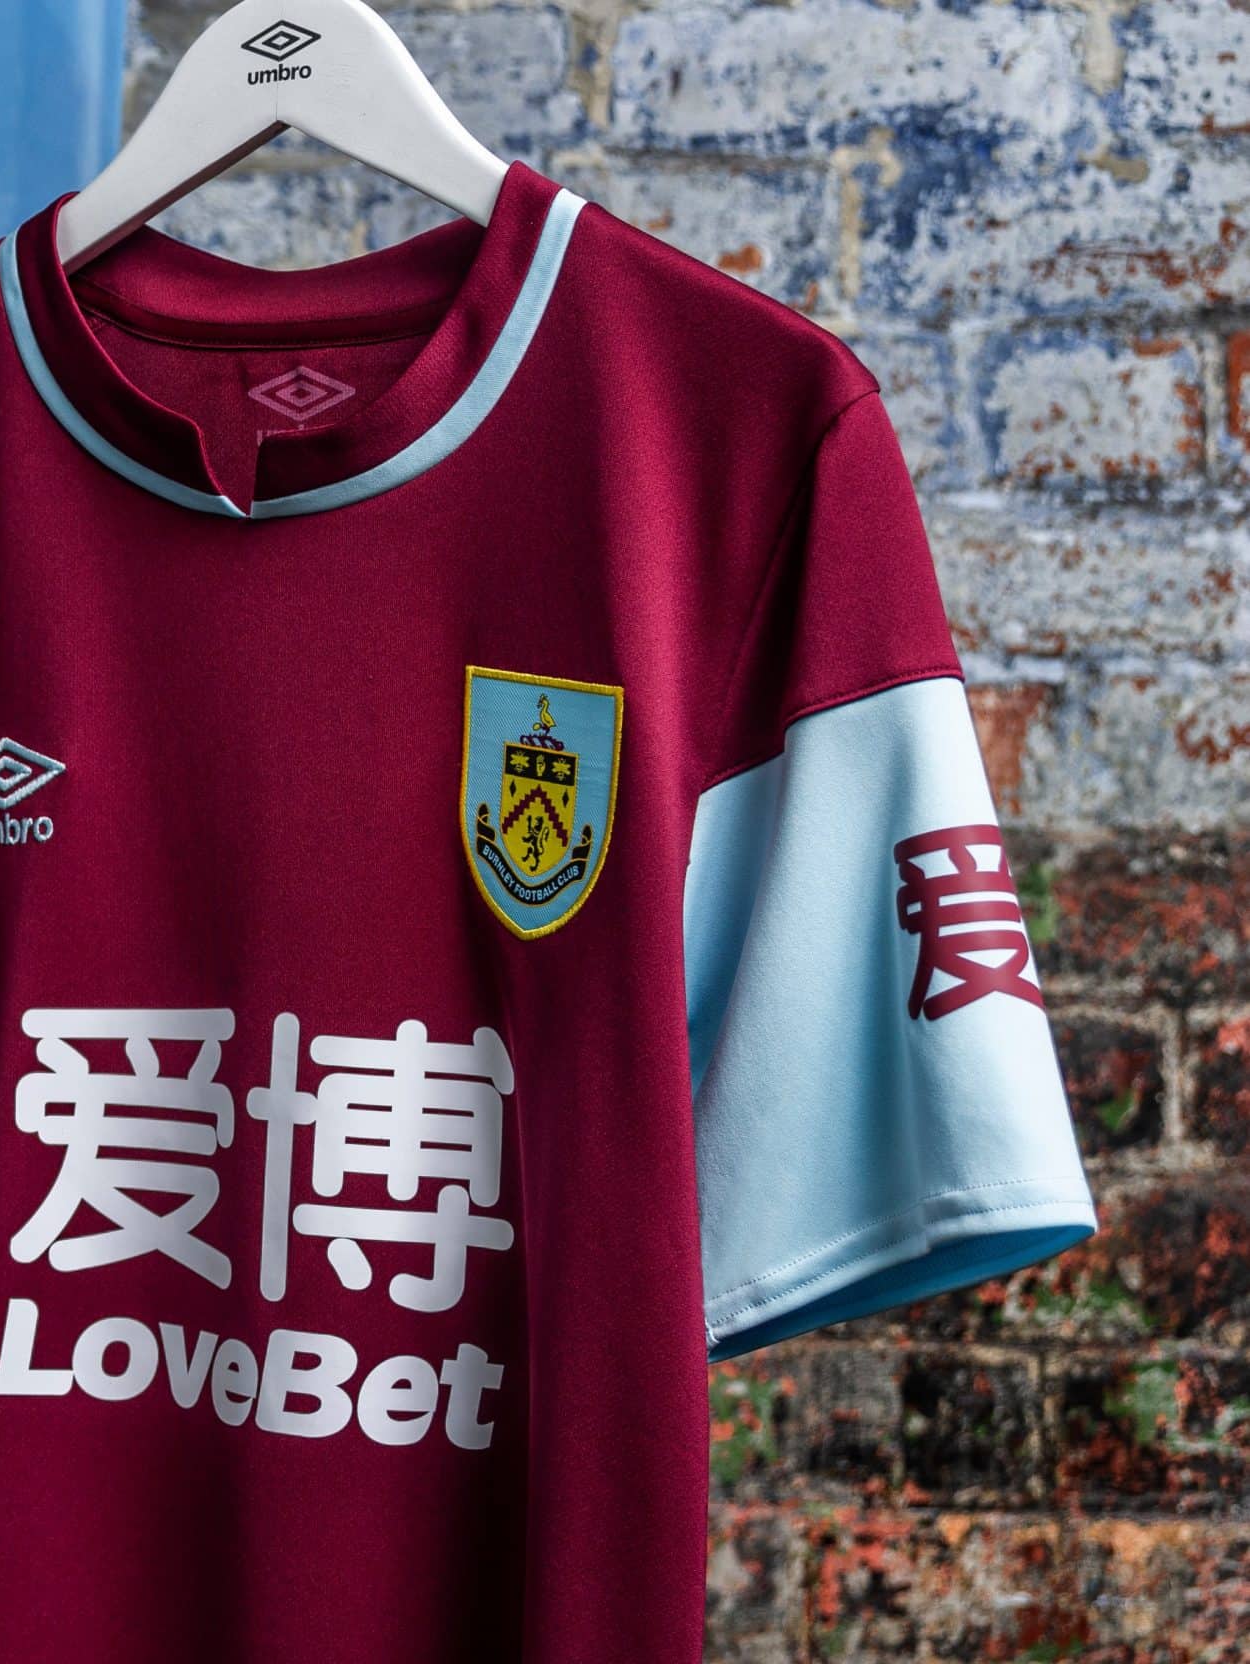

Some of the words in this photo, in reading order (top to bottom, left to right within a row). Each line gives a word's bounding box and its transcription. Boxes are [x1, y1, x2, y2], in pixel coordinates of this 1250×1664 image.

[247, 63, 312, 85] umbro
[482, 844, 515, 888] BURNLEY
[514, 882, 559, 902] FOOTBALL
[9, 1008, 514, 1313] 爱博
